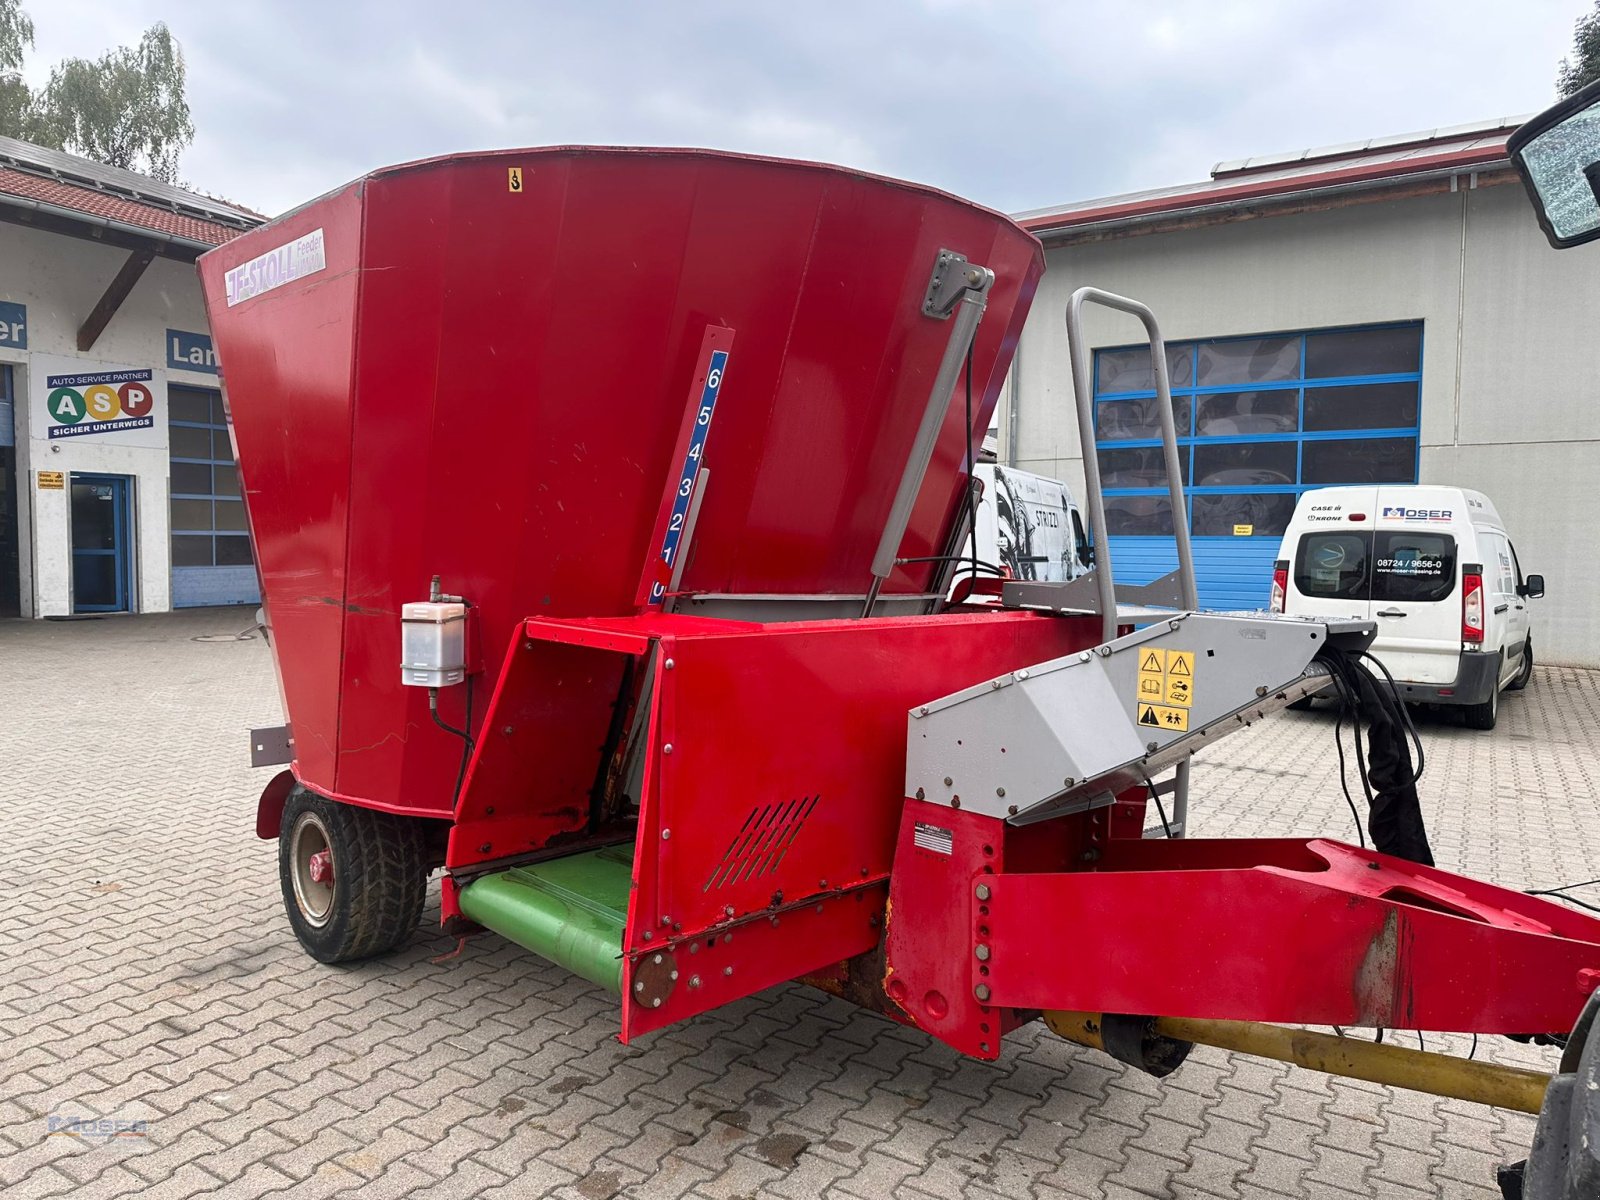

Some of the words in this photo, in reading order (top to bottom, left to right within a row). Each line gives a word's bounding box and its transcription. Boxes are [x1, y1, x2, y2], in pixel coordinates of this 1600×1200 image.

[297, 235, 322, 258] Feeder
[51, 376, 75, 386] AUTO
[76, 374, 111, 384] SERVICE
[113, 372, 149, 381] PARTNER
[708, 368, 721, 388] 6
[698, 406, 711, 425] 5
[53, 426, 90, 436] SICHER
[93, 419, 150, 431] UNTERWEGS
[689, 443, 701, 461] 4
[679, 478, 692, 496] 3
[669, 513, 683, 531] 2
[663, 547, 672, 563] 1
[1377, 559, 1403, 567] 08724
[1411, 560, 1442, 568] 9656-0
